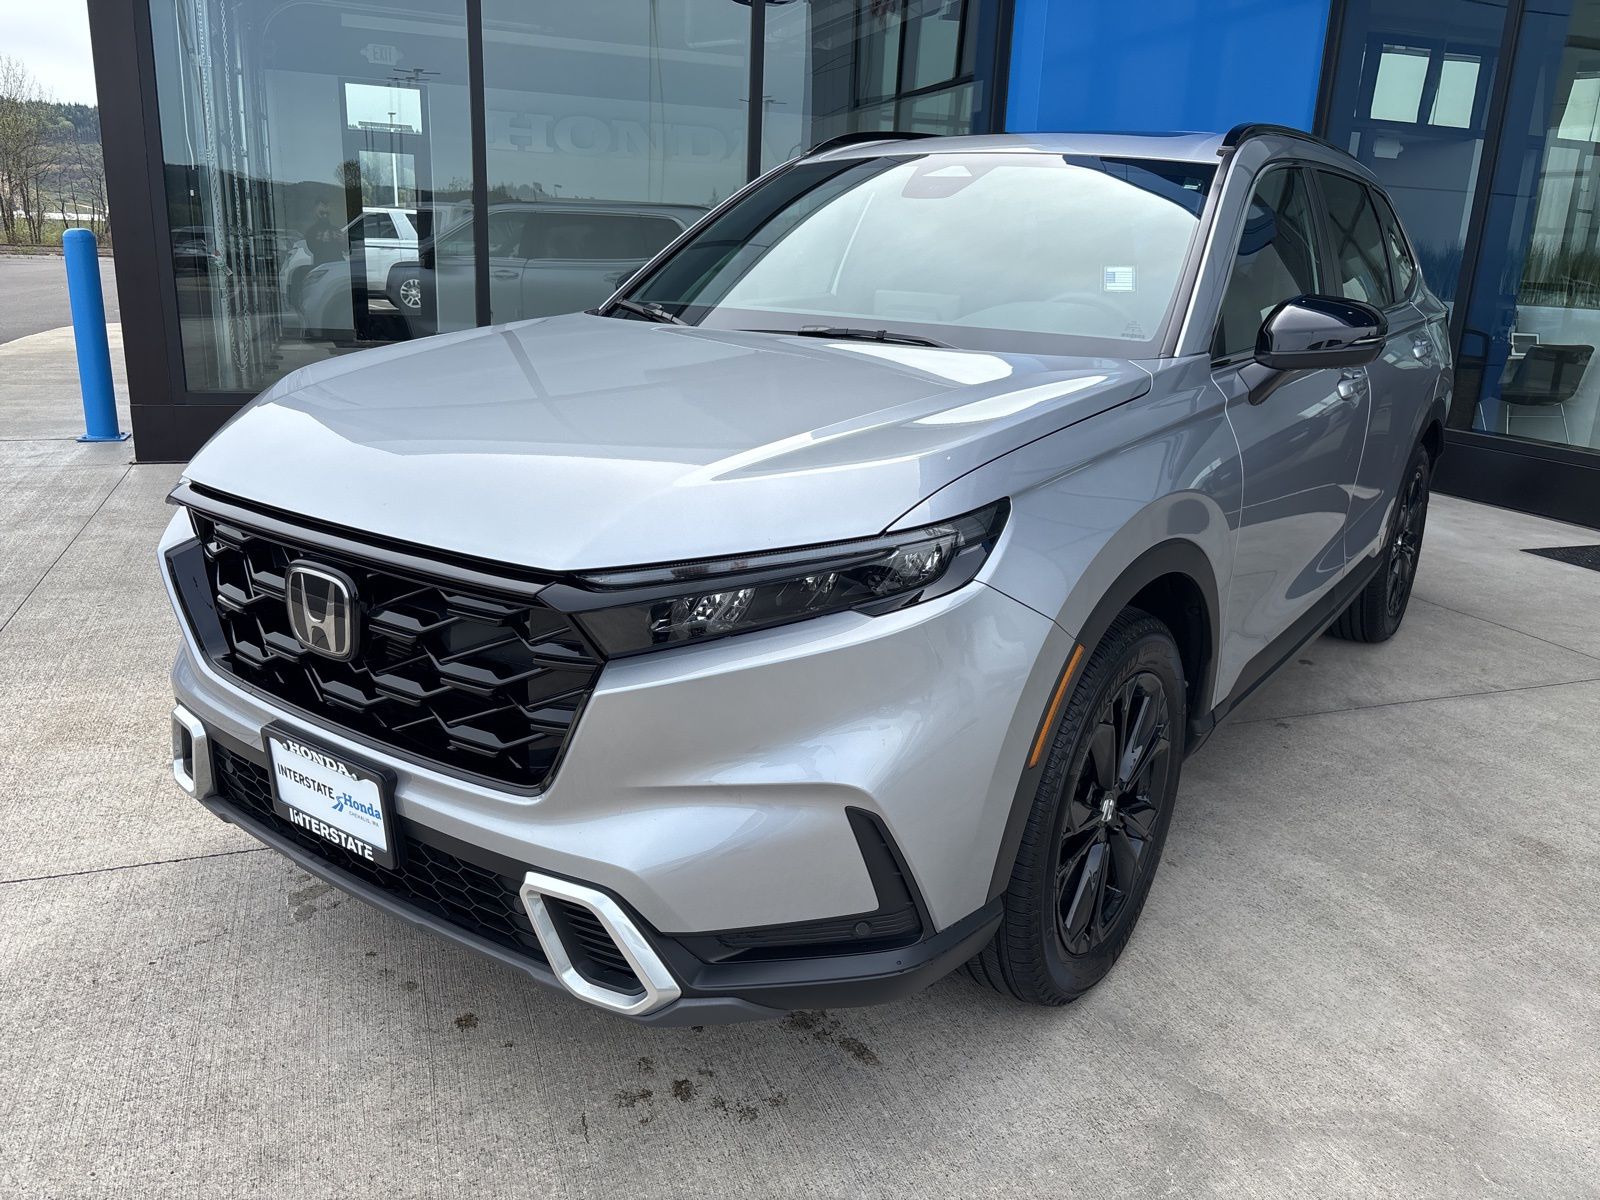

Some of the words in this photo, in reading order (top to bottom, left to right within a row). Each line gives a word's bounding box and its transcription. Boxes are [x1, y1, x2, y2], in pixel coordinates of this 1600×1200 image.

[287, 739, 350, 777] HONDA
[277, 762, 335, 800] INTERSTATE
[342, 792, 382, 821] Honda
[288, 807, 375, 862] INTERSTATE
